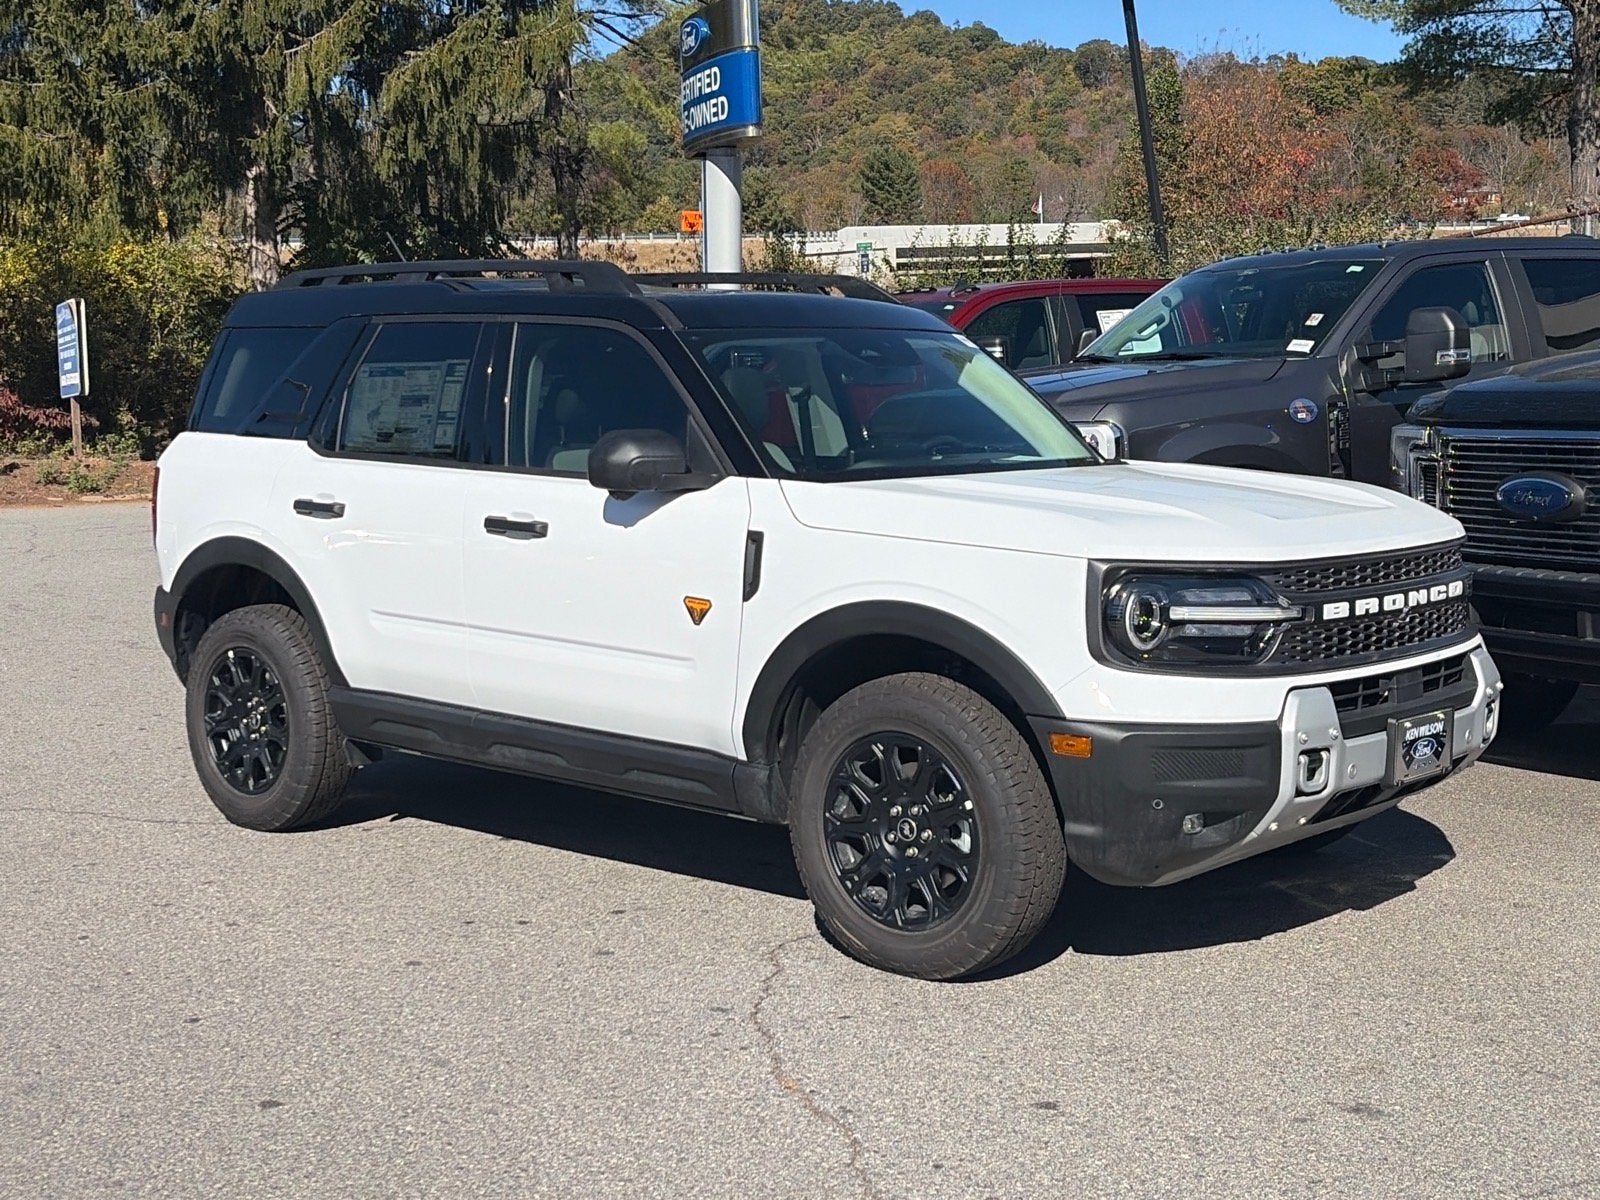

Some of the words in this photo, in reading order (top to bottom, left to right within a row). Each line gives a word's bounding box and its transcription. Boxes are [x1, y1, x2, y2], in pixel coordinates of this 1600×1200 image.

[682, 26, 696, 52] Ford
[682, 66, 720, 104] ERTIFIED
[683, 96, 728, 133] E-OWNED
[1513, 490, 1553, 506] Ford
[1323, 580, 1463, 620] BRONCO
[1405, 727, 1420, 741] KEN
[1419, 720, 1445, 737] WILSON
[1415, 740, 1432, 757] Ford
